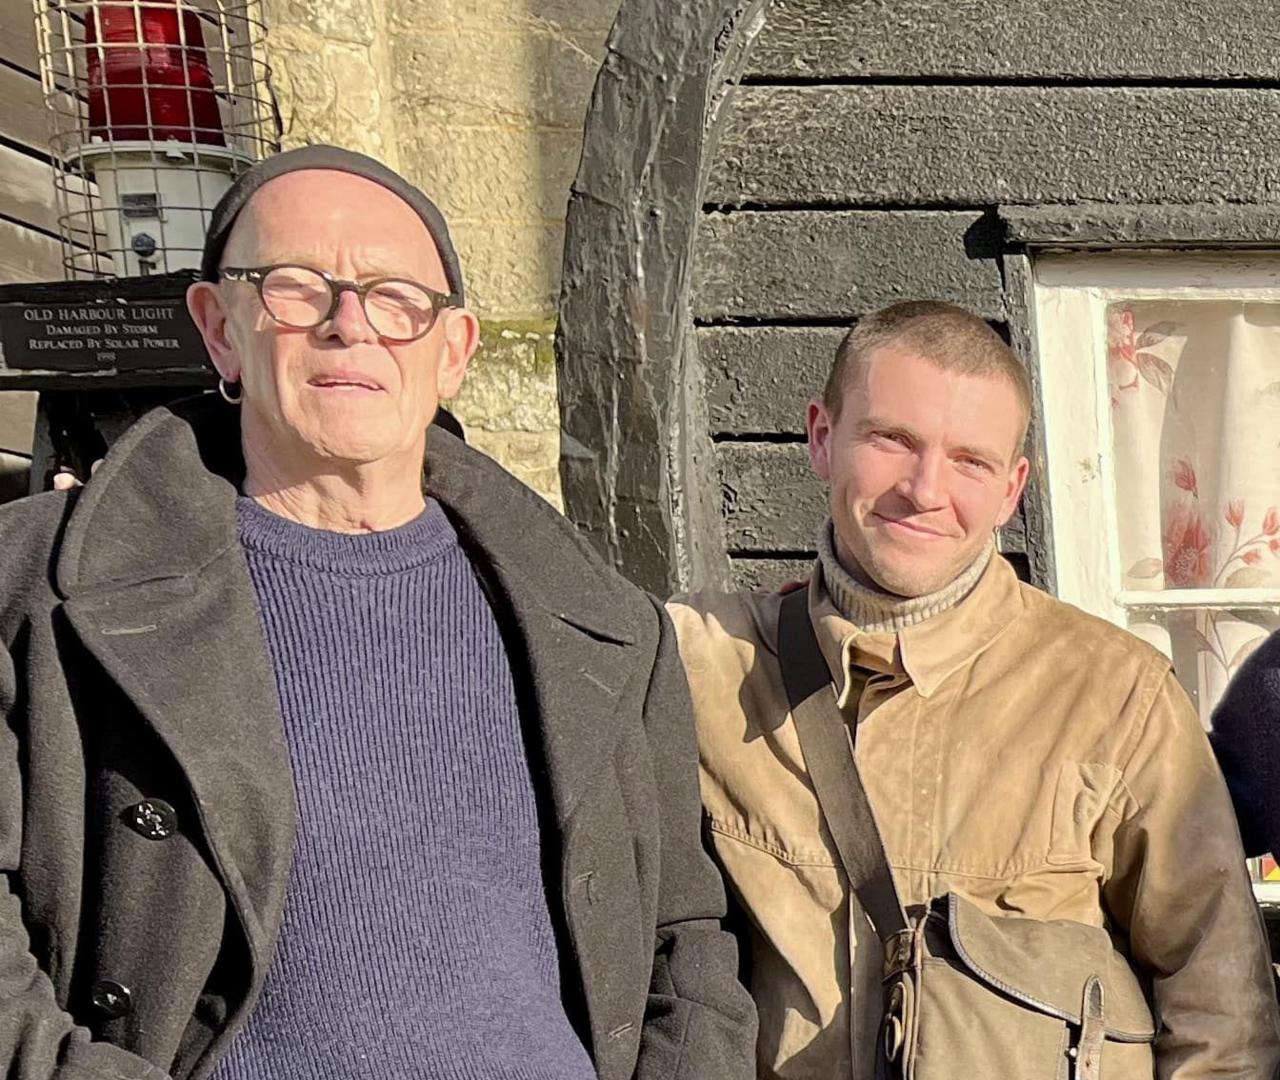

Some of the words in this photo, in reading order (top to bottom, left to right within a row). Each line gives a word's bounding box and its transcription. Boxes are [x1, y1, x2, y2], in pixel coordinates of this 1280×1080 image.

[24, 308, 53, 321] OLD
[59, 308, 126, 321] HARBOUR
[132, 307, 174, 320] LIGHT
